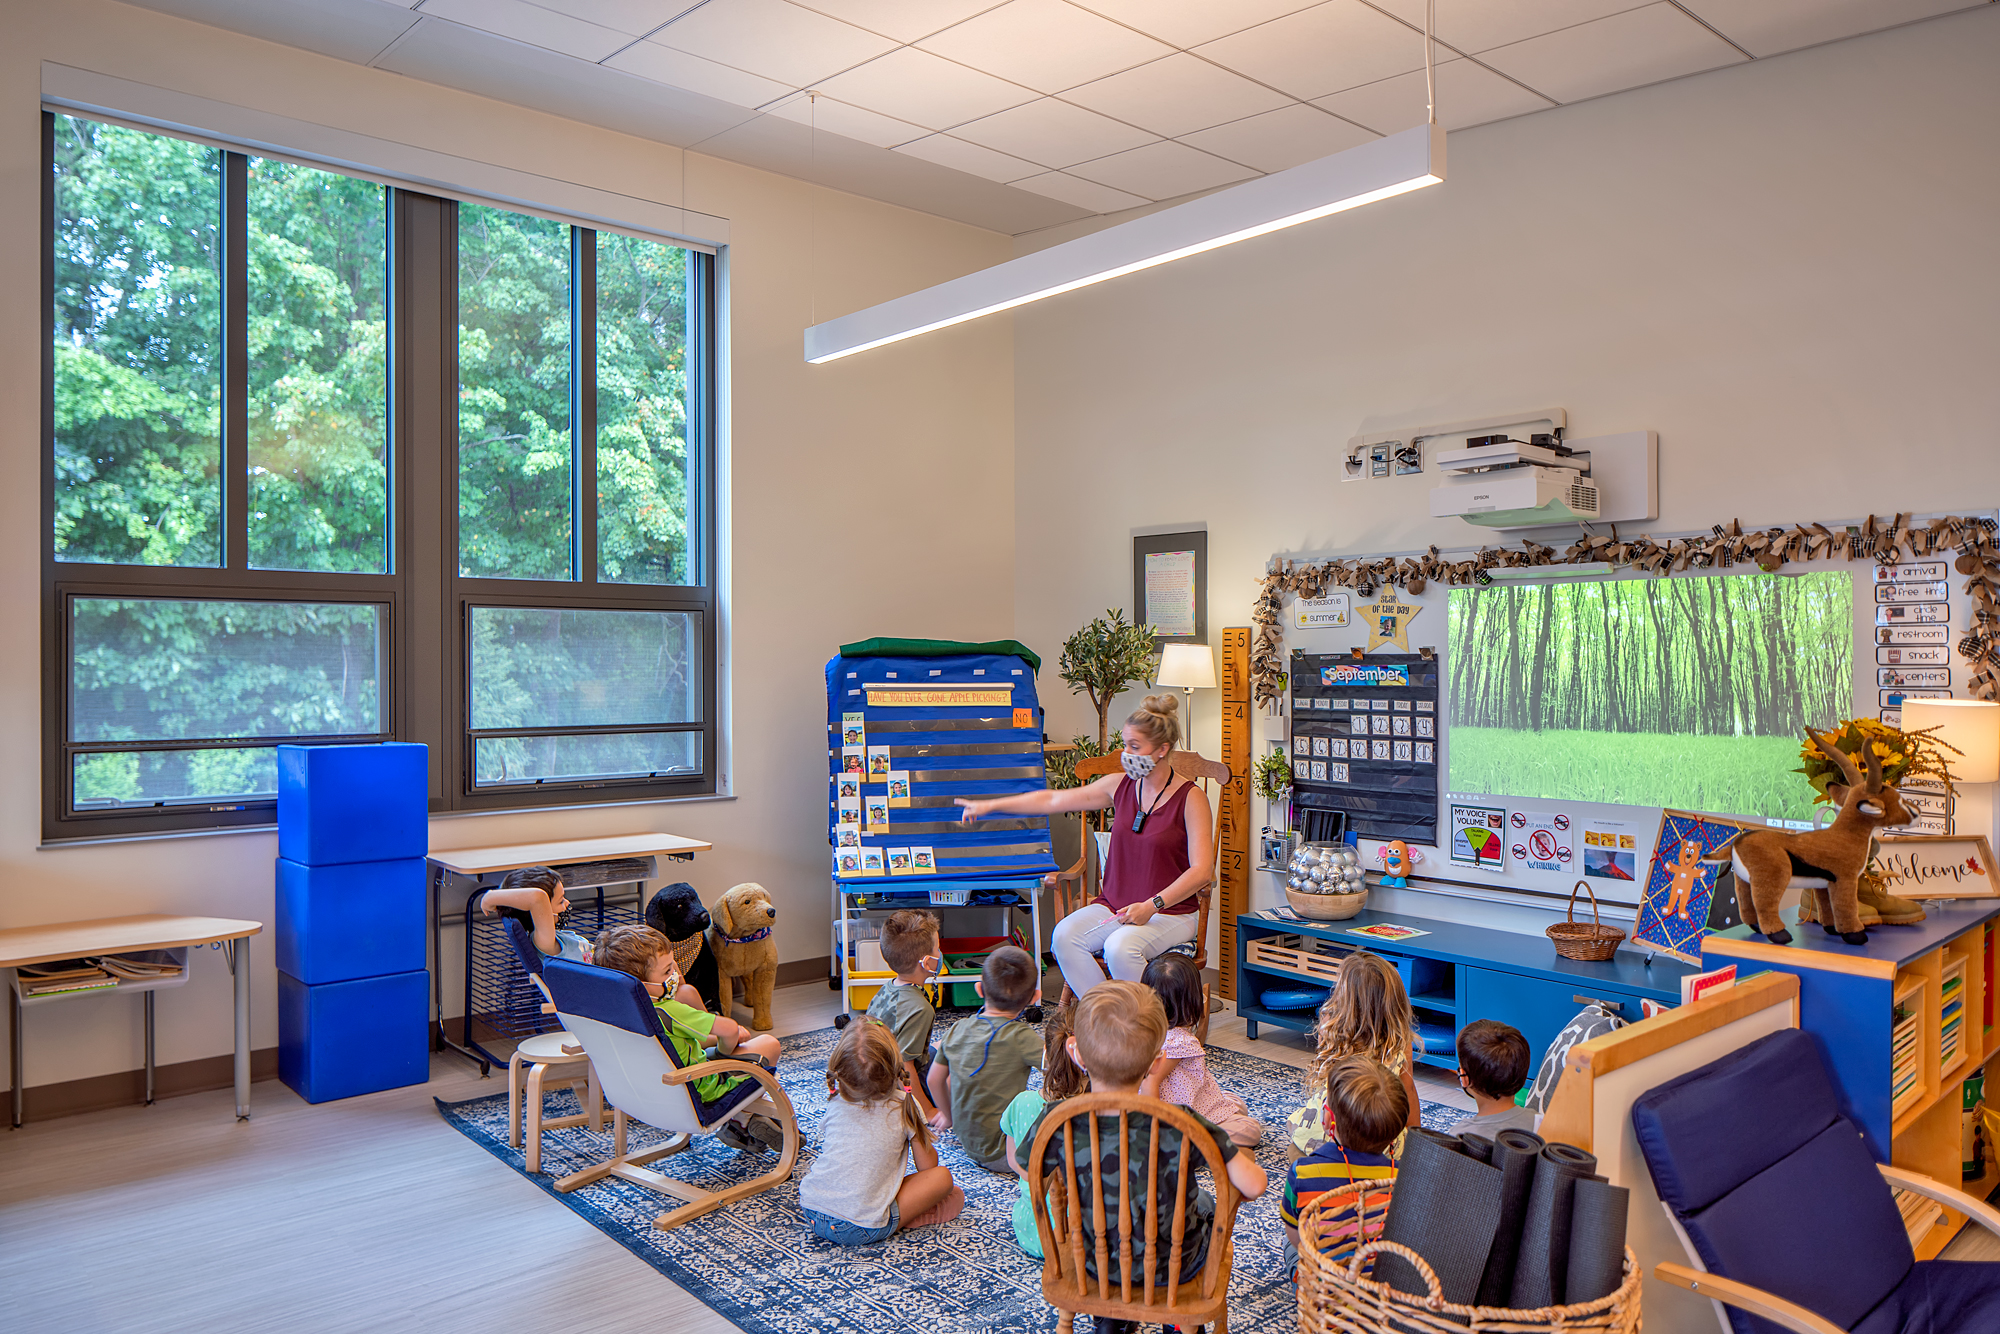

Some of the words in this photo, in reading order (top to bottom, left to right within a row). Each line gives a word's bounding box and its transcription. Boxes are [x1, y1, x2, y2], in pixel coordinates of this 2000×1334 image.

[1903, 566, 1937, 576] arrival
[1898, 588, 1918, 596] free
[1924, 587, 1945, 596] time
[1914, 606, 1938, 614] circle
[1310, 614, 1337, 622] summer
[1916, 614, 1936, 622] time
[1898, 630, 1944, 638] restroom
[1238, 632, 1245, 648] 5
[1908, 650, 1940, 660] snack
[1328, 667, 1400, 684] September
[1906, 672, 1946, 681] centers
[868, 692, 886, 702] HAVE
[889, 692, 902, 702] YOU
[904, 692, 924, 702] EVER
[926, 692, 946, 703] GONE
[949, 692, 970, 702] APPLE
[972, 692, 1008, 702] PICKING?
[1015, 713, 1028, 724] NO
[1236, 706, 1244, 720] 4
[1377, 718, 1384, 734] 2
[1400, 718, 1405, 734] 3
[1422, 722, 1428, 736] 4
[1300, 738, 1305, 753] 5
[1318, 740, 1324, 754] 6
[1336, 742, 1342, 756] 7
[1356, 742, 1361, 758] 8
[1378, 743, 1384, 758] 9
[1398, 743, 1406, 759] 10
[1422, 744, 1427, 760] 11
[1300, 762, 1305, 777] 12
[1316, 764, 1322, 778] 13
[1337, 765, 1344, 780] 14
[1236, 780, 1244, 796] 3
[1466, 810, 1486, 818] VOICE
[1456, 816, 1484, 826] VOLUME
[1234, 854, 1242, 870] 2
[1874, 852, 1971, 888] Welcome
